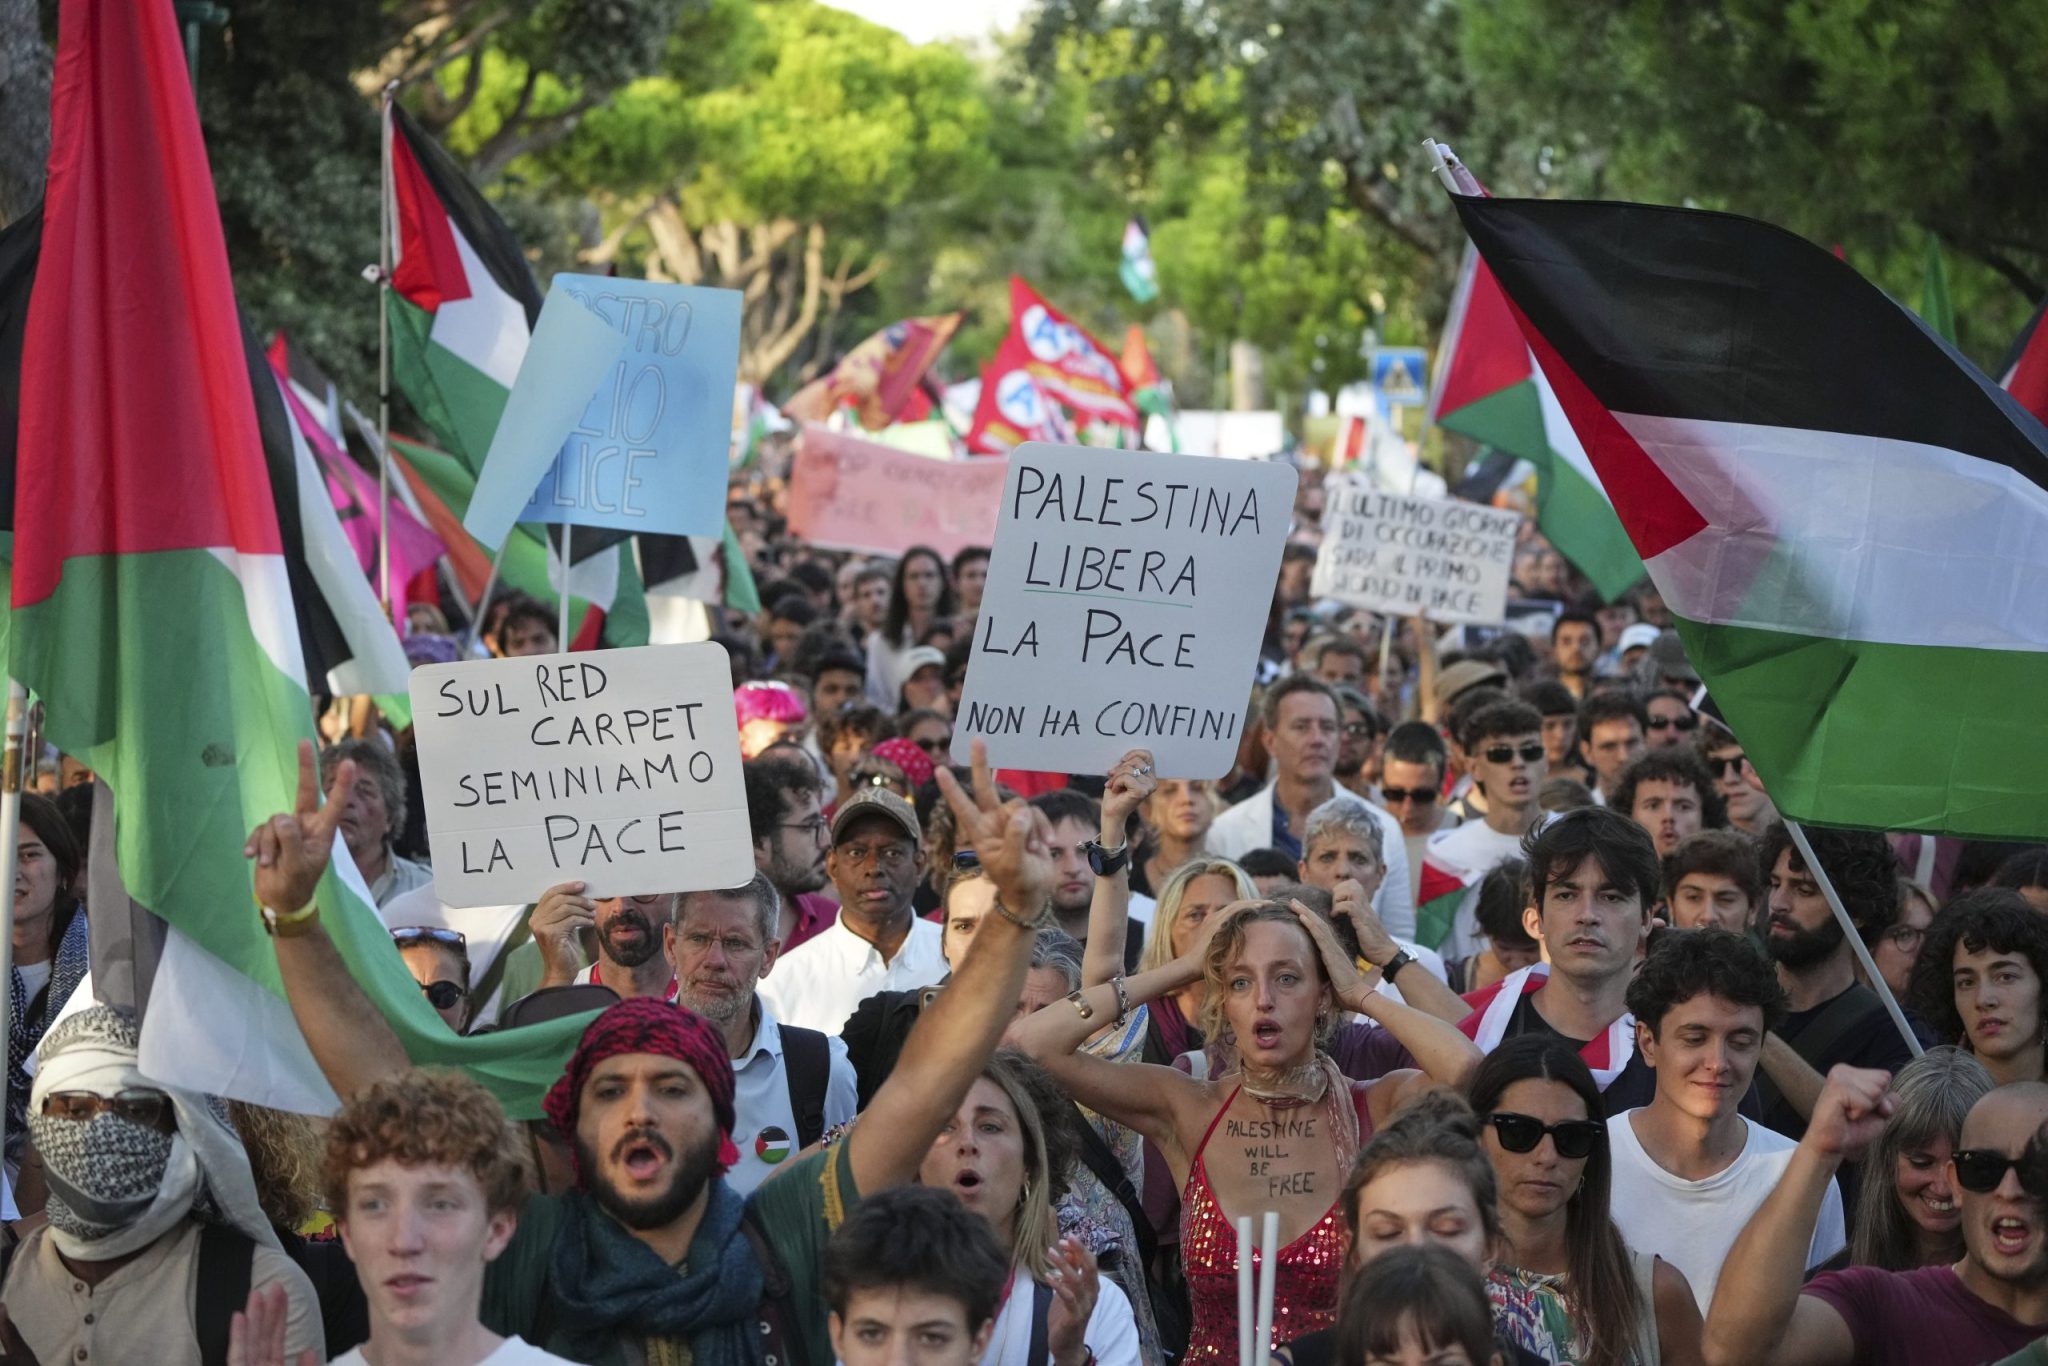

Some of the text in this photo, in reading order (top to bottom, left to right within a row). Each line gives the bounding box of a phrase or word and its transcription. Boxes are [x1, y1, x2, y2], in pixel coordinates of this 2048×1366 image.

[564, 288, 692, 357] STRO
[530, 442, 658, 517] LICE
[1013, 466, 1261, 536] PALESTINA
[1341, 520, 1365, 541] DI
[1025, 541, 1197, 597] LIBERA
[1416, 554, 1482, 586] PRIMO
[981, 608, 1196, 668] LA PACE
[437, 662, 607, 717] SUL RED
[531, 703, 703, 746] CARPET
[965, 700, 1236, 740] NON HA CONFINI
[454, 751, 714, 807] SEMINIAMO
[462, 811, 686, 874] LA PACE
[1225, 1119, 1317, 1140] PALESTINE
[1244, 1144, 1289, 1159] WILL
[1249, 1161, 1271, 1177] BE
[1268, 1171, 1316, 1198] FREE
